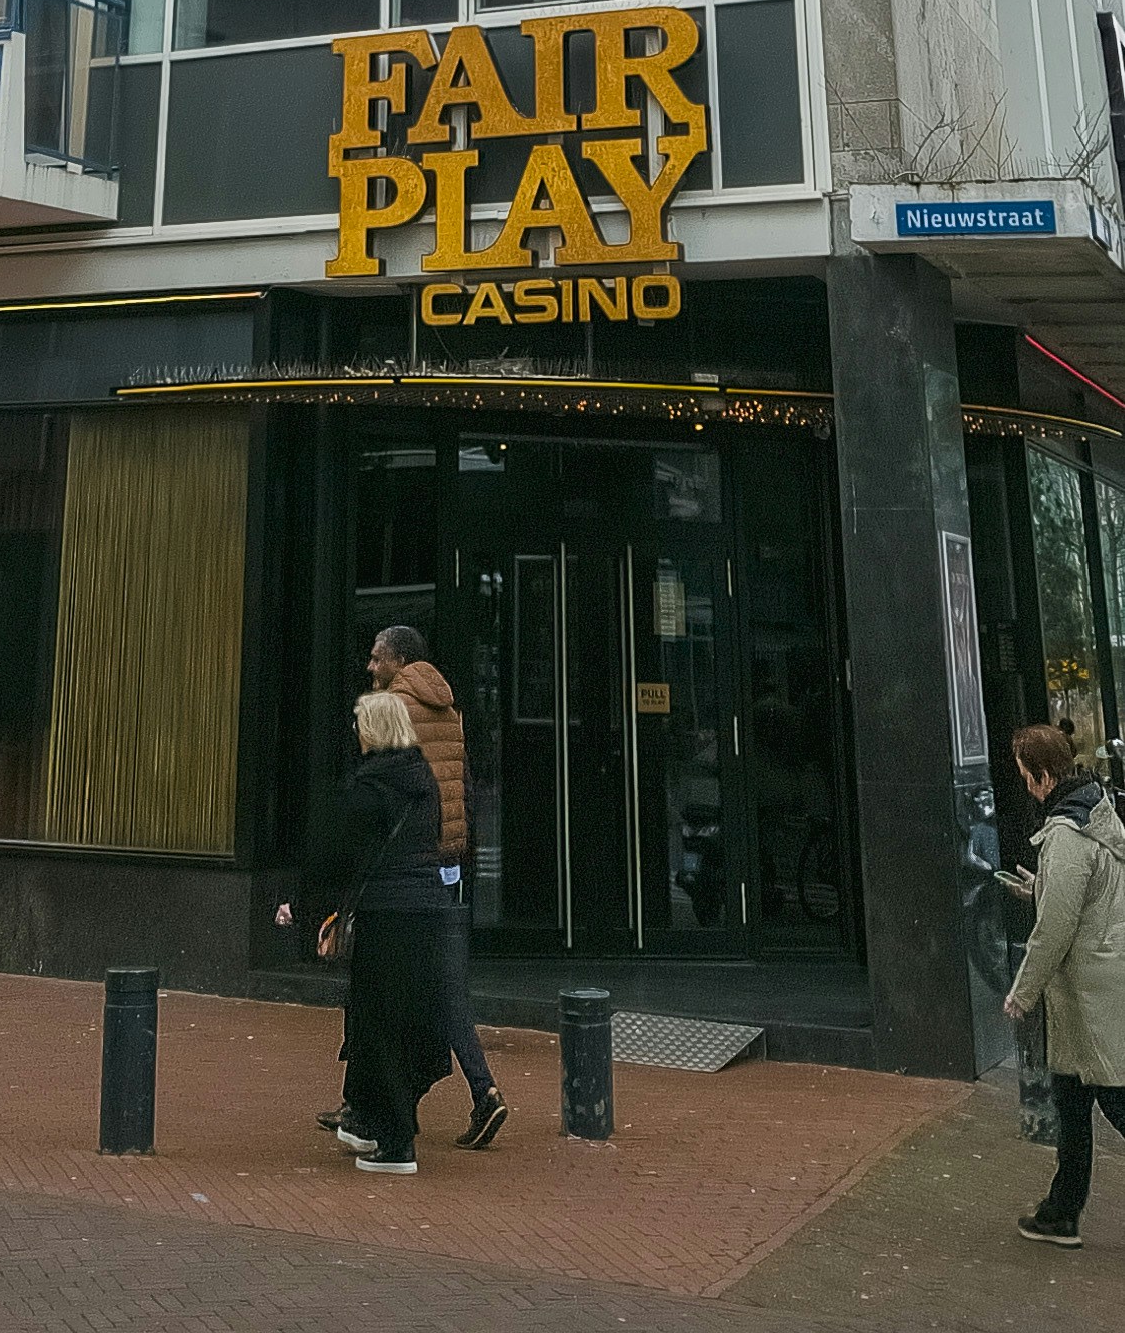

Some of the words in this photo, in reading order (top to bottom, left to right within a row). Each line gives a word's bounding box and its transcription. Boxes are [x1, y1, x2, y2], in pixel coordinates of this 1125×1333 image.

[329, 6, 708, 149] FAIR
[326, 133, 710, 278] PLAY
[906, 207, 1046, 230] Nieuwstraat
[421, 275, 681, 325] CASINO
[641, 689, 666, 699] PULL
